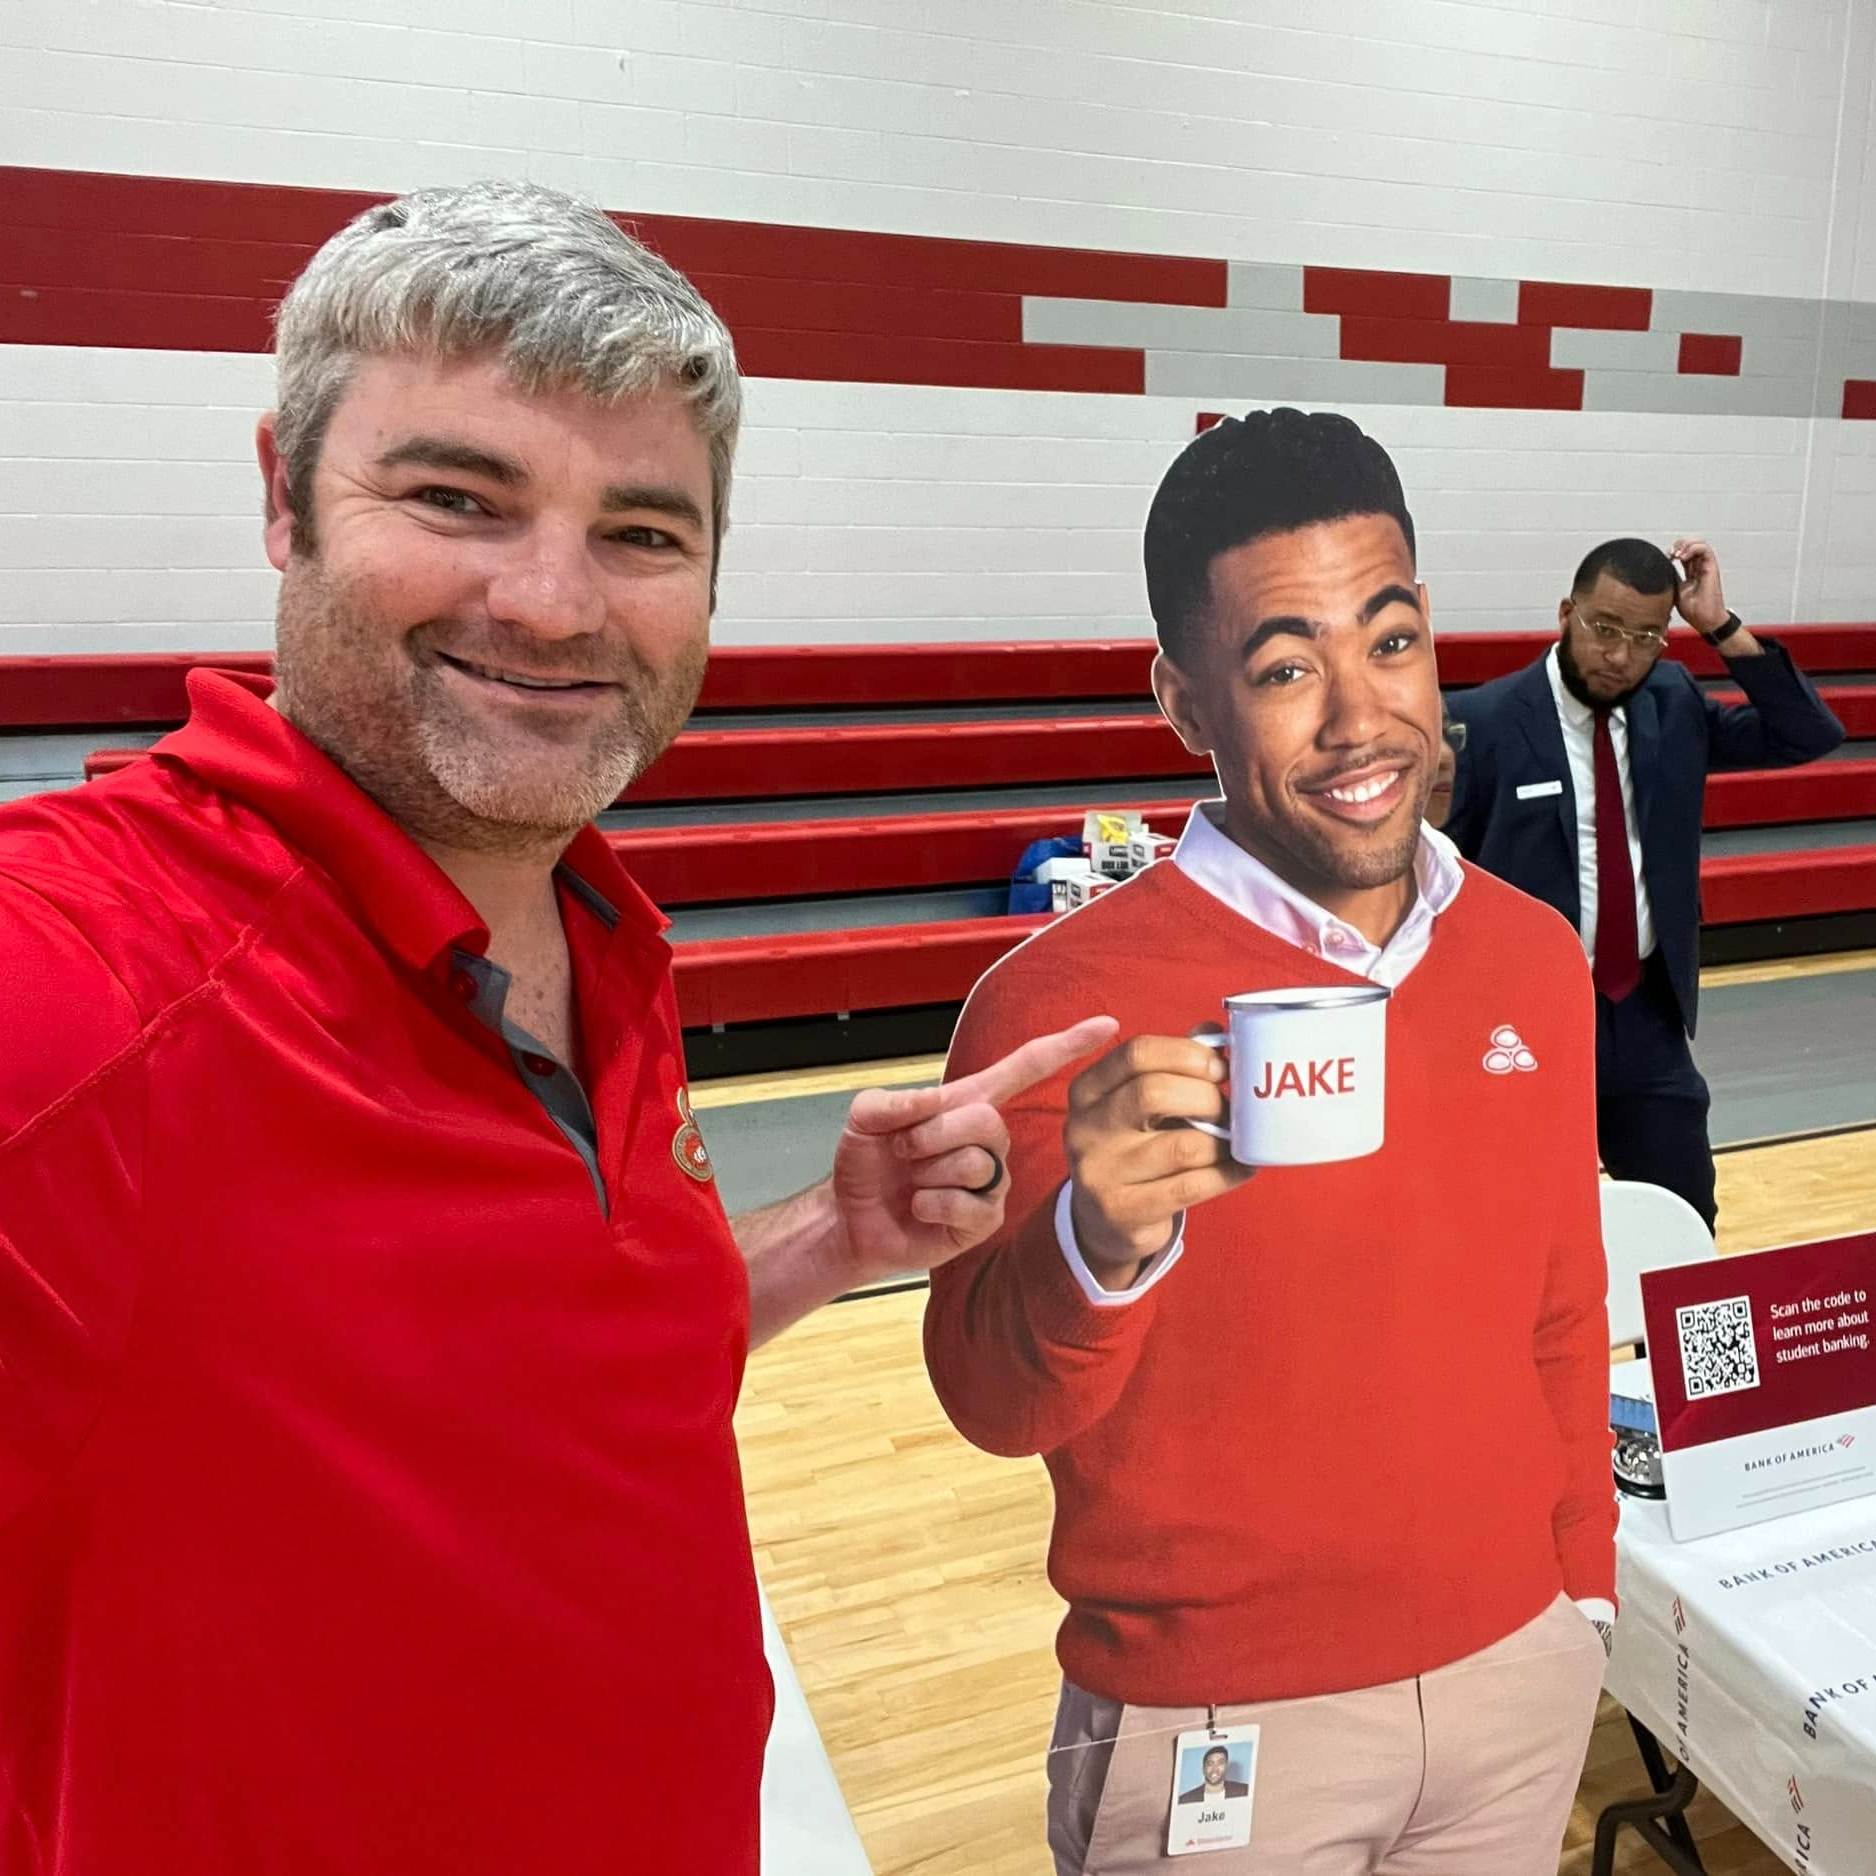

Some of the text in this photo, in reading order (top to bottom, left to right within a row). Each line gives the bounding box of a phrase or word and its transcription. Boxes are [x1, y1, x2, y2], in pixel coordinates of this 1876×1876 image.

[1253, 1057, 1355, 1099] JAKE
[1770, 1289, 1867, 1319] Scan the code to
[1772, 1310, 1869, 1341] learn more about
[1776, 1333, 1870, 1363] student banking.
[1744, 1442, 1835, 1472] BANK OF AMERICA
[1718, 1568, 1775, 1590] BANK
[1774, 1560, 1798, 1574] OF
[1677, 1643, 1690, 1737] AMERICA
[1803, 1678, 1869, 1740] BANK OF
[1197, 1810, 1226, 1824] Jake
